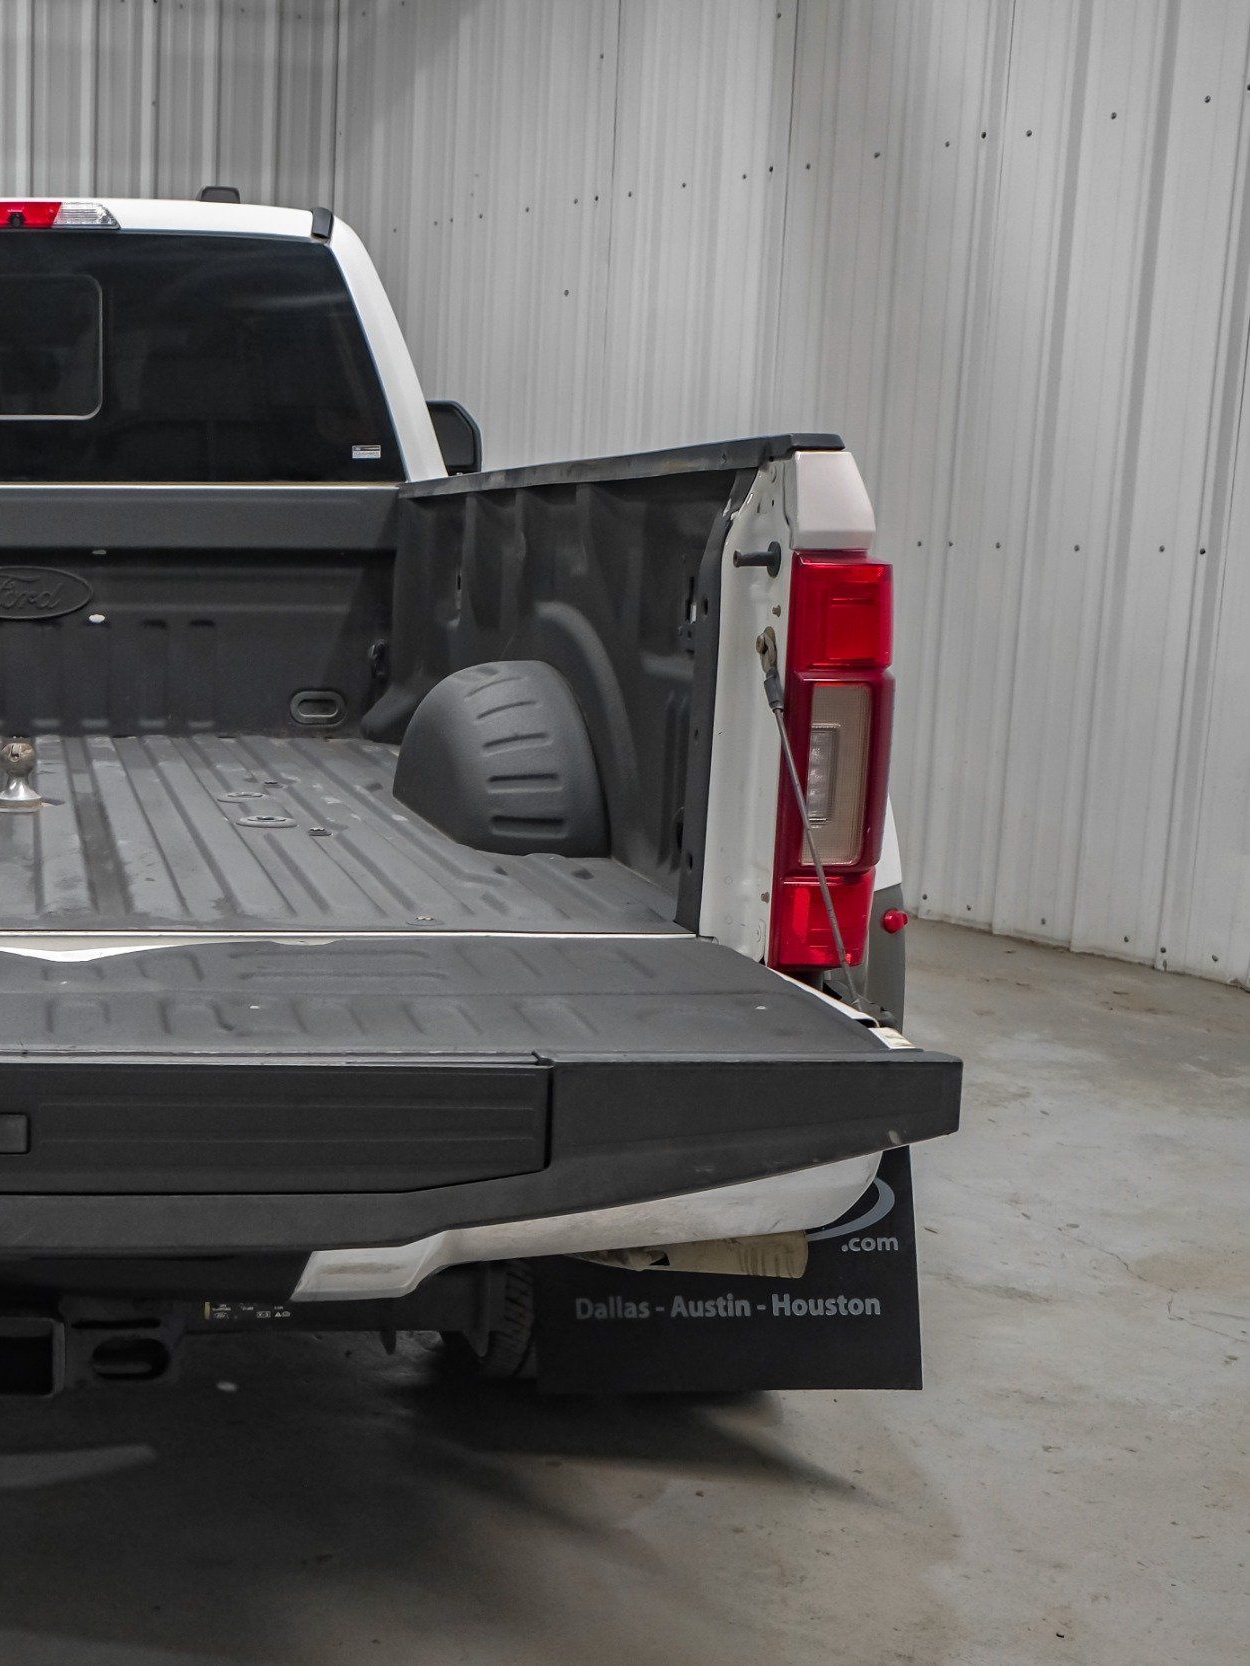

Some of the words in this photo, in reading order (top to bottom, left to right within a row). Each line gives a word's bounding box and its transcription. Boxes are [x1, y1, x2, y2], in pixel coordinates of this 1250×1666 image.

[841, 1235, 899, 1252] .com
[575, 1296, 650, 1320] Dallas
[670, 1292, 752, 1318] Austin
[771, 1293, 881, 1317] Houston
